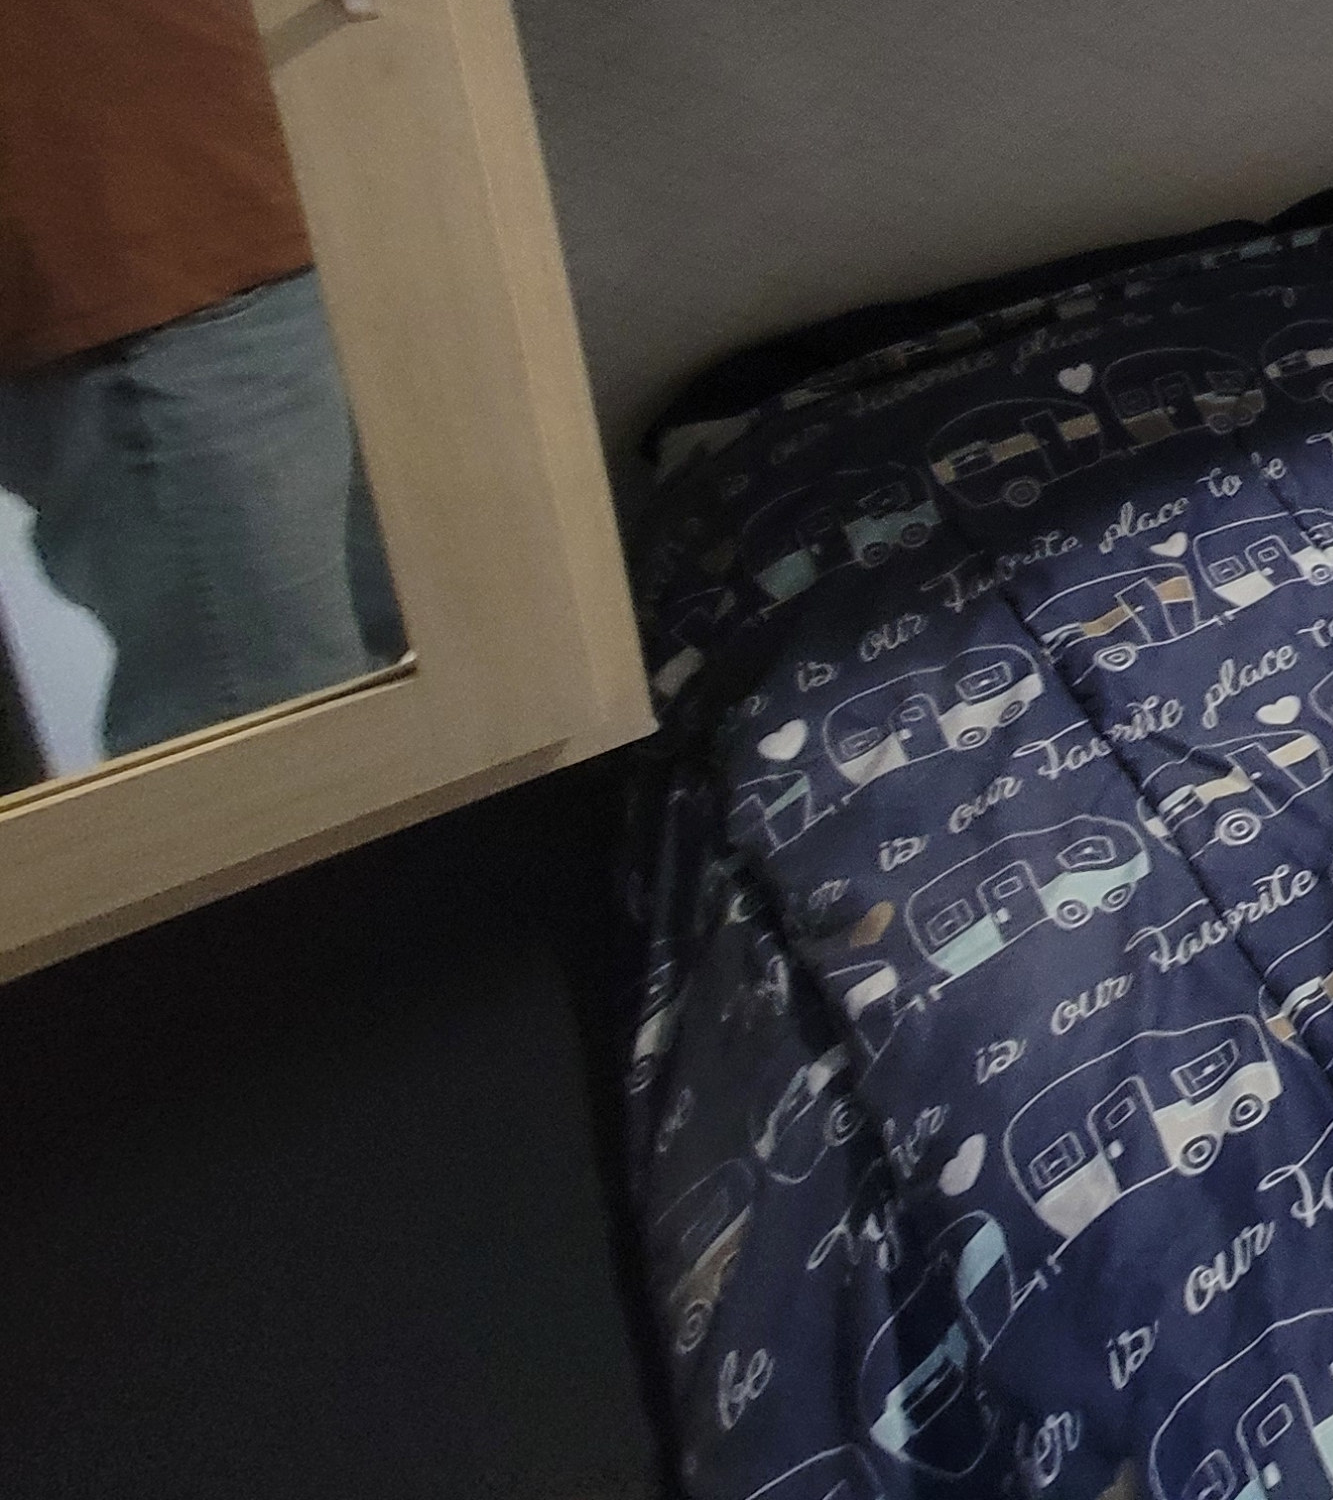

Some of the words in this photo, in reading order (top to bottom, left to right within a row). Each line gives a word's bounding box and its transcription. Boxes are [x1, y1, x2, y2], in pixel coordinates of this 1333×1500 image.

[859, 613, 928, 662] our
[1099, 497, 1189, 554] place
[1195, 467, 1242, 501] to
[878, 833, 930, 874] is
[947, 776, 1024, 835] our
[1201, 644, 1301, 730] place
[974, 1037, 1028, 1086] is
[1050, 973, 1134, 1037] our
[1123, 864, 1319, 974] Favorite
[1106, 1320, 1160, 1391] is
[1183, 1219, 1277, 1315] our
